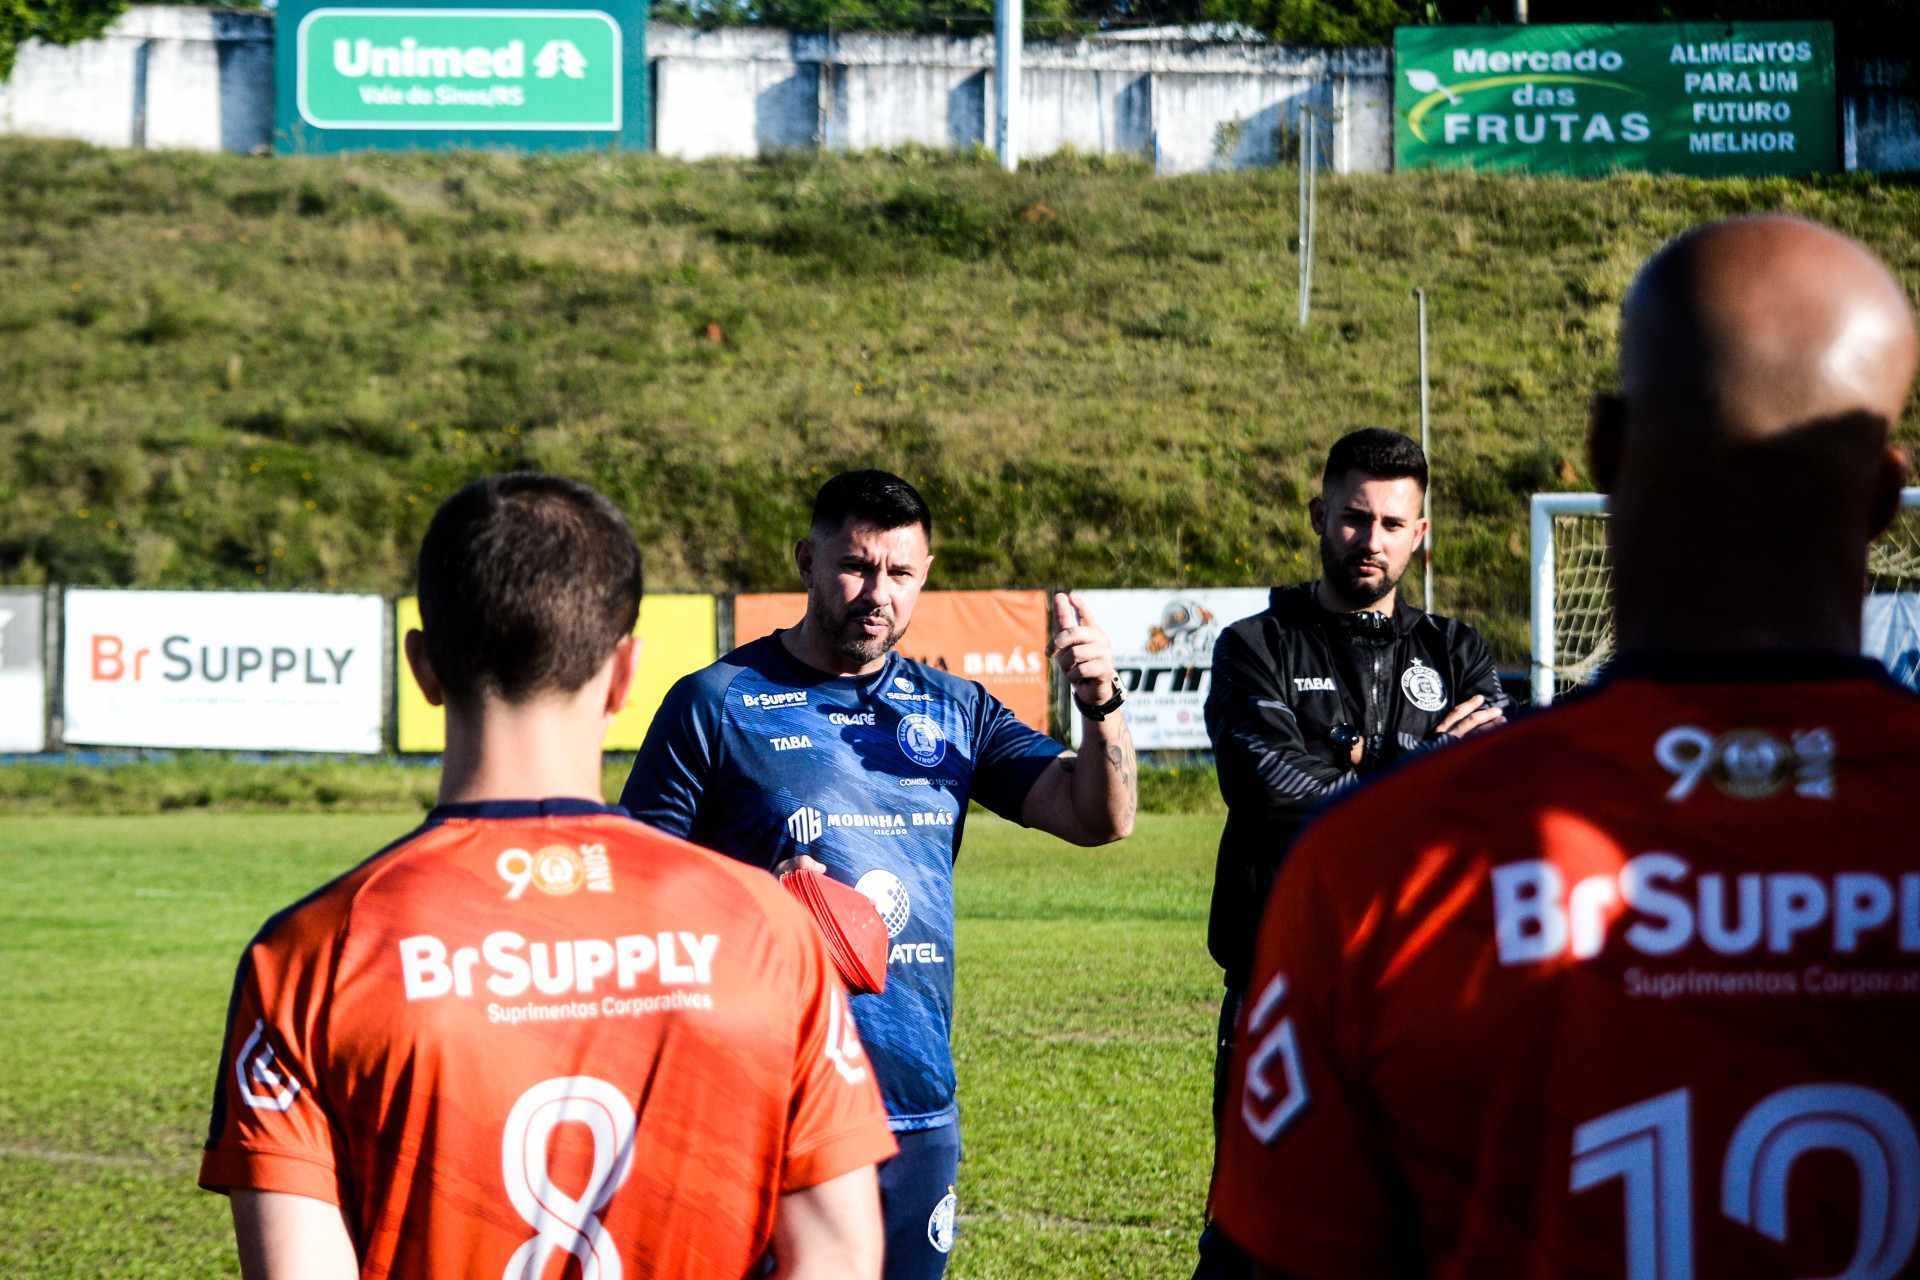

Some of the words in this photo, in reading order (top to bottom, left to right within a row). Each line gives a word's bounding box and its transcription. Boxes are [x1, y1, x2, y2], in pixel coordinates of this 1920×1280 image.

[333, 37, 524, 78] Unimed
[1453, 48, 1623, 73] Mercado
[1670, 41, 1812, 64] ALIMENTOS
[1685, 71, 1752, 93] PARA
[1759, 71, 1798, 92] UM
[1513, 84, 1576, 106] das
[1693, 102, 1791, 123] FUTURO
[1444, 112, 1650, 144] FRUTAS
[1689, 132, 1794, 153] MELHOR
[963, 646, 1041, 674] BRÁS
[1294, 677, 1337, 692] TABA
[770, 734, 813, 751] TABA
[912, 808, 954, 826] BRÁS
[886, 942, 944, 964] ATEL
[1624, 967, 1797, 998] Suprimentos
[487, 1000, 598, 1024] Suprimentos
[602, 990, 713, 1018] Corporativos
[502, 1075, 637, 1280] 8
